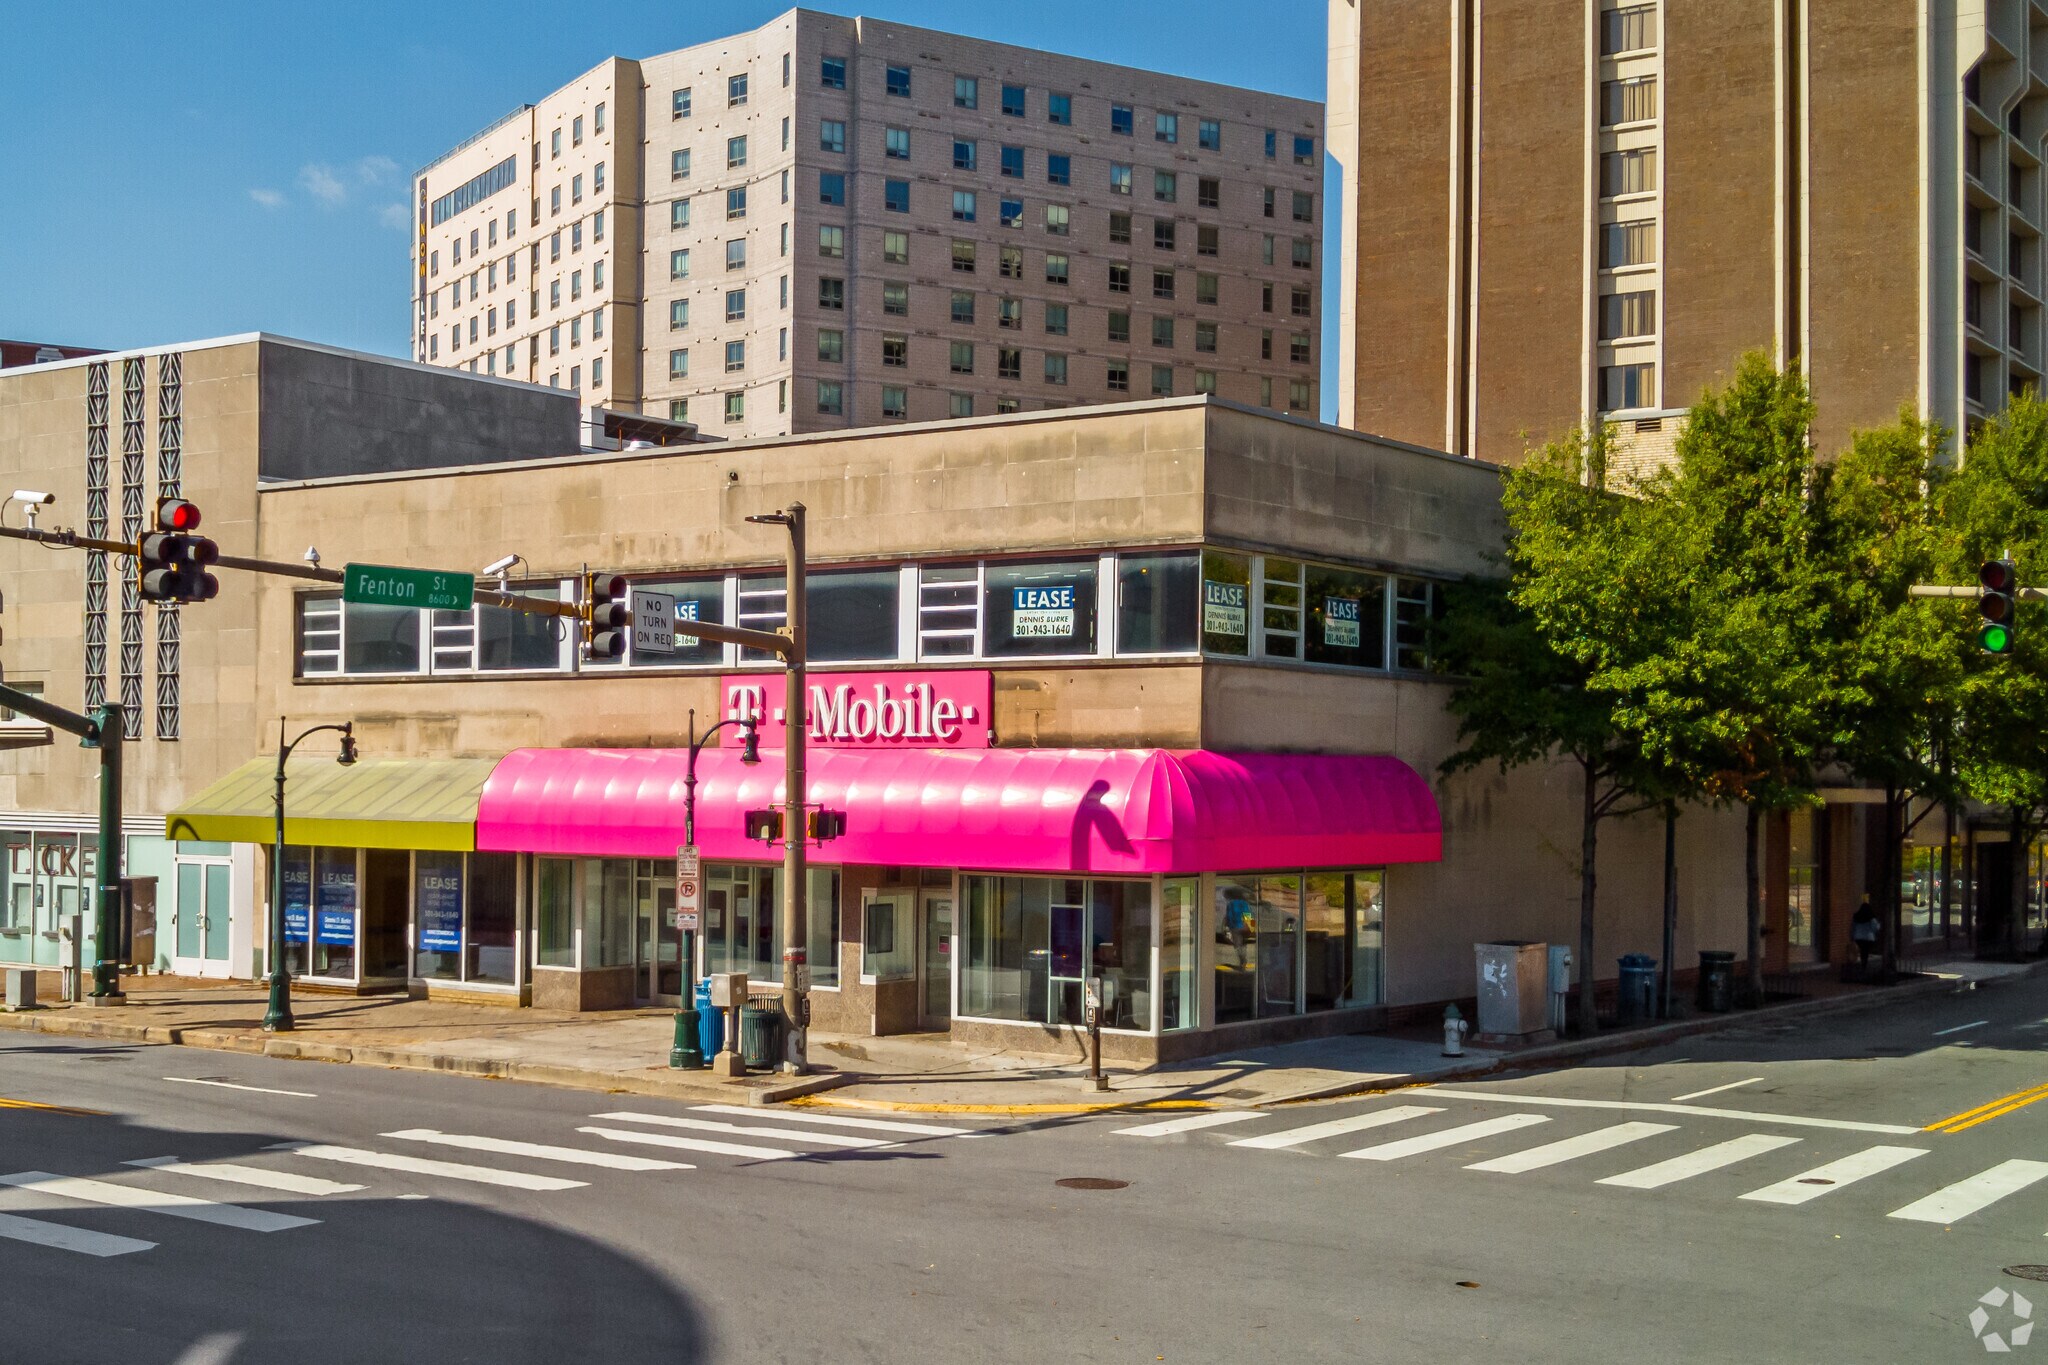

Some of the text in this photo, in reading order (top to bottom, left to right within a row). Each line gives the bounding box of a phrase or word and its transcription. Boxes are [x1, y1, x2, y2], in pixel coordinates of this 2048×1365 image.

[359, 574, 447, 598] Fenton St
[428, 593, 450, 604] 8600
[1018, 591, 1070, 608] LEASE
[1207, 584, 1243, 606] LEASE
[646, 600, 662, 611] NO
[675, 604, 696, 620] ASE
[1327, 599, 1358, 620] LEASE
[642, 615, 667, 629] TURN
[1206, 620, 1244, 634] 301-943-1640
[1016, 624, 1071, 635] 301-943-1640
[637, 631, 672, 645] ON RED
[675, 635, 697, 645] 3-1640
[809, 683, 958, 738] Mobile
[6, 843, 125, 878] TICKE
[284, 871, 309, 883] EASE
[322, 873, 354, 886] LEASE
[425, 876, 458, 890] LEASE
